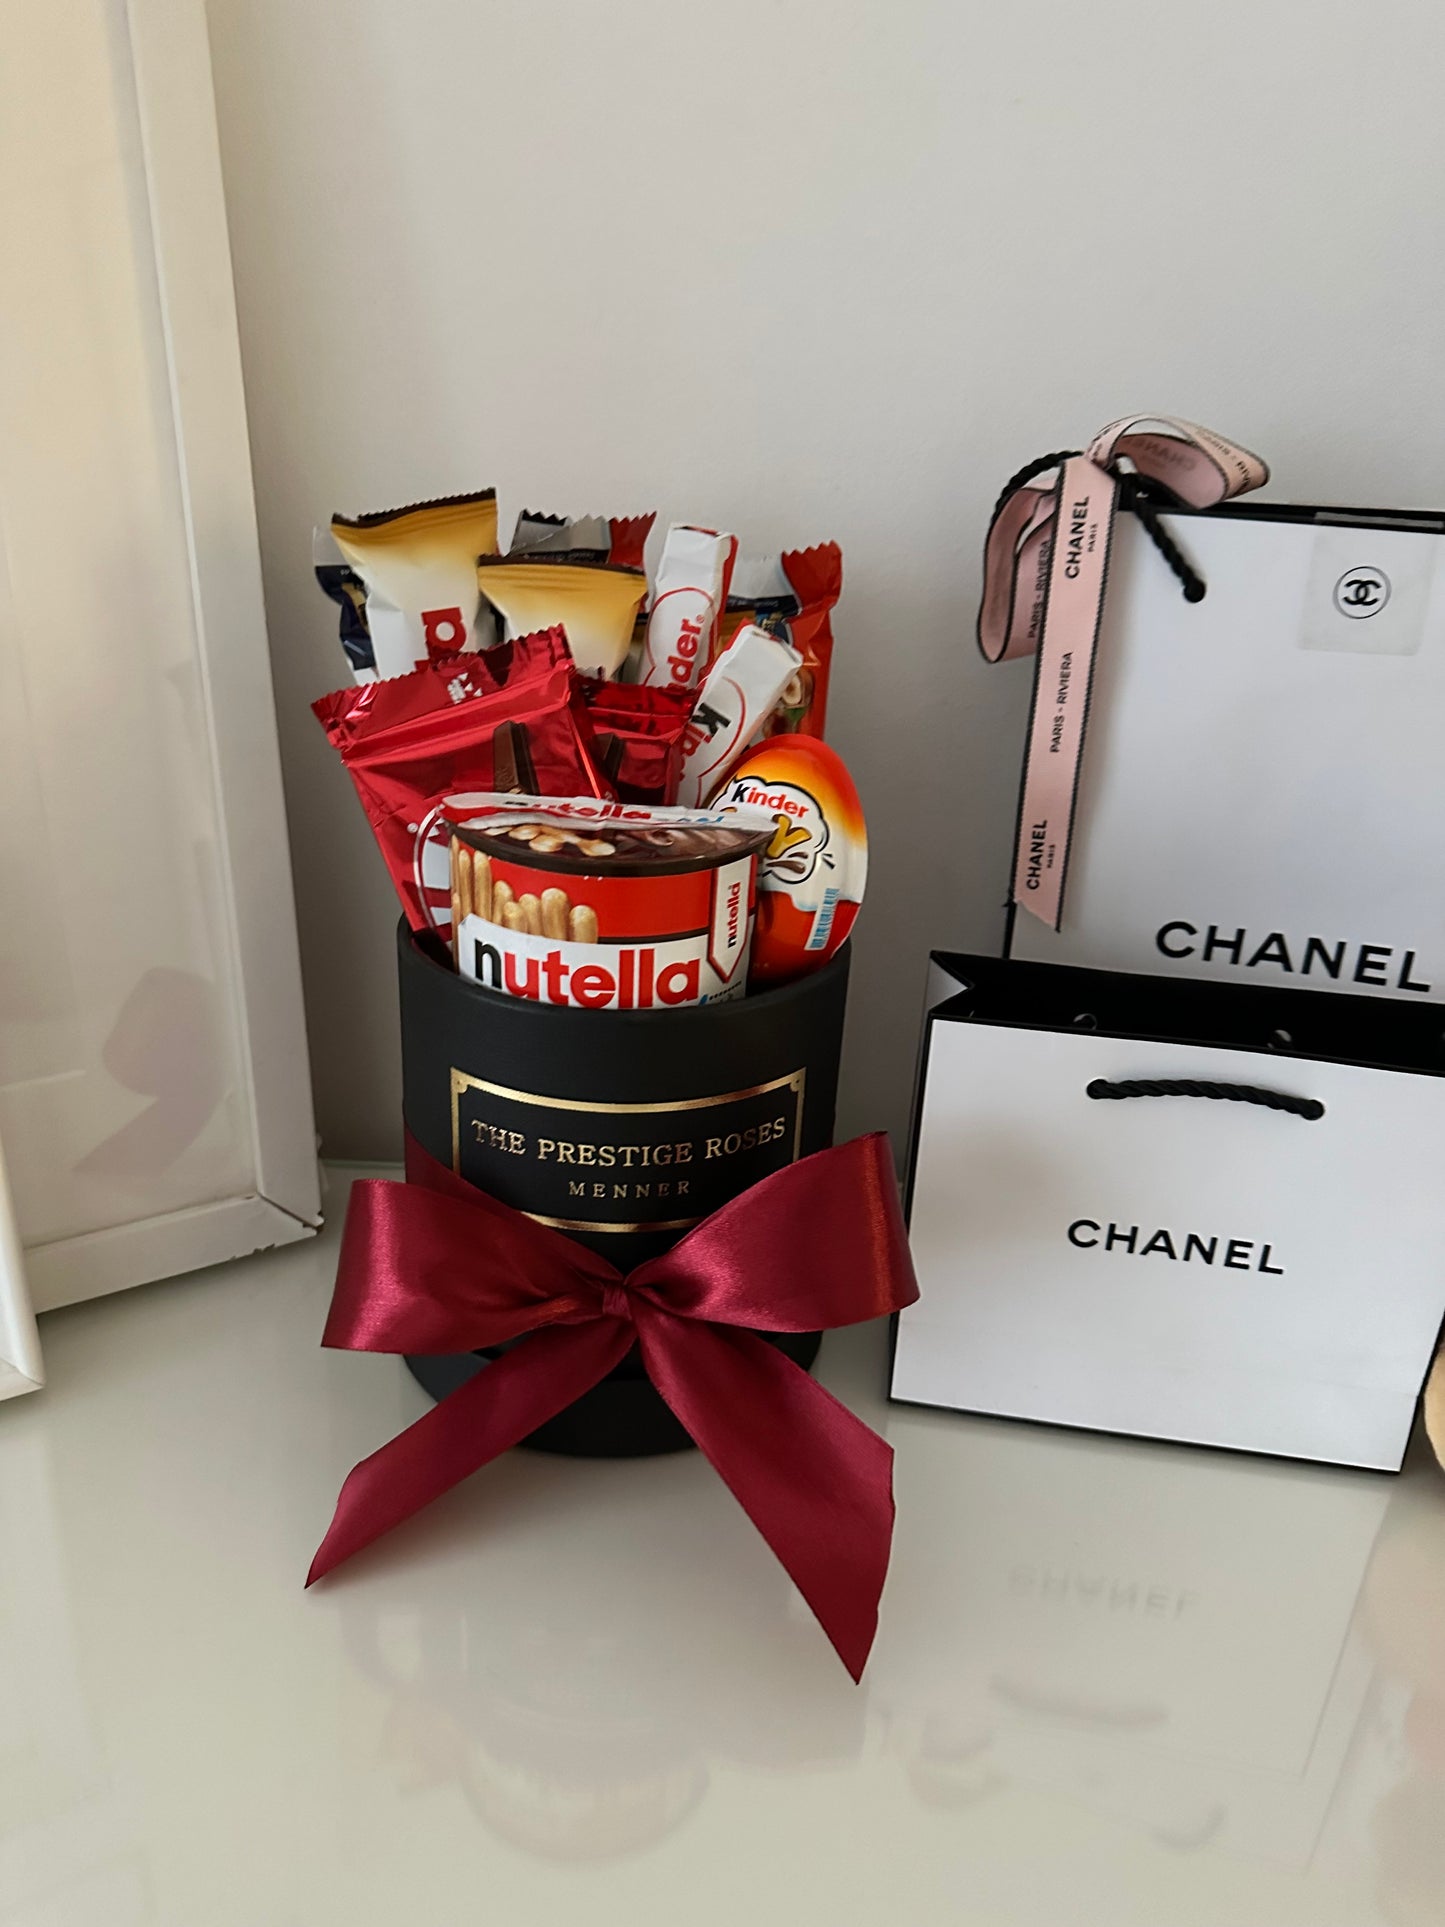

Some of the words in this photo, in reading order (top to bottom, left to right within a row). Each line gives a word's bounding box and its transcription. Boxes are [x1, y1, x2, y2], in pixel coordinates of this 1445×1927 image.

[1065, 496, 1090, 579] CHANEL
[1088, 523, 1098, 552] PARIS
[1028, 602, 1043, 638] PARIS
[1057, 652, 1073, 704] RIVIERA
[1051, 715, 1064, 753] PARIS
[731, 783, 810, 819] Kinder
[1026, 820, 1048, 890] CHANEL
[727, 881, 741, 949] nutella
[474, 938, 701, 1010] nutella
[1156, 921, 1432, 993] CHANEL
[471, 1119, 526, 1156] THE
[537, 1138, 693, 1167] PRESTIGE
[704, 1116, 786, 1159] ROSES
[568, 1179, 690, 1198] MENNER
[1067, 1219, 1284, 1275] CHANEL
